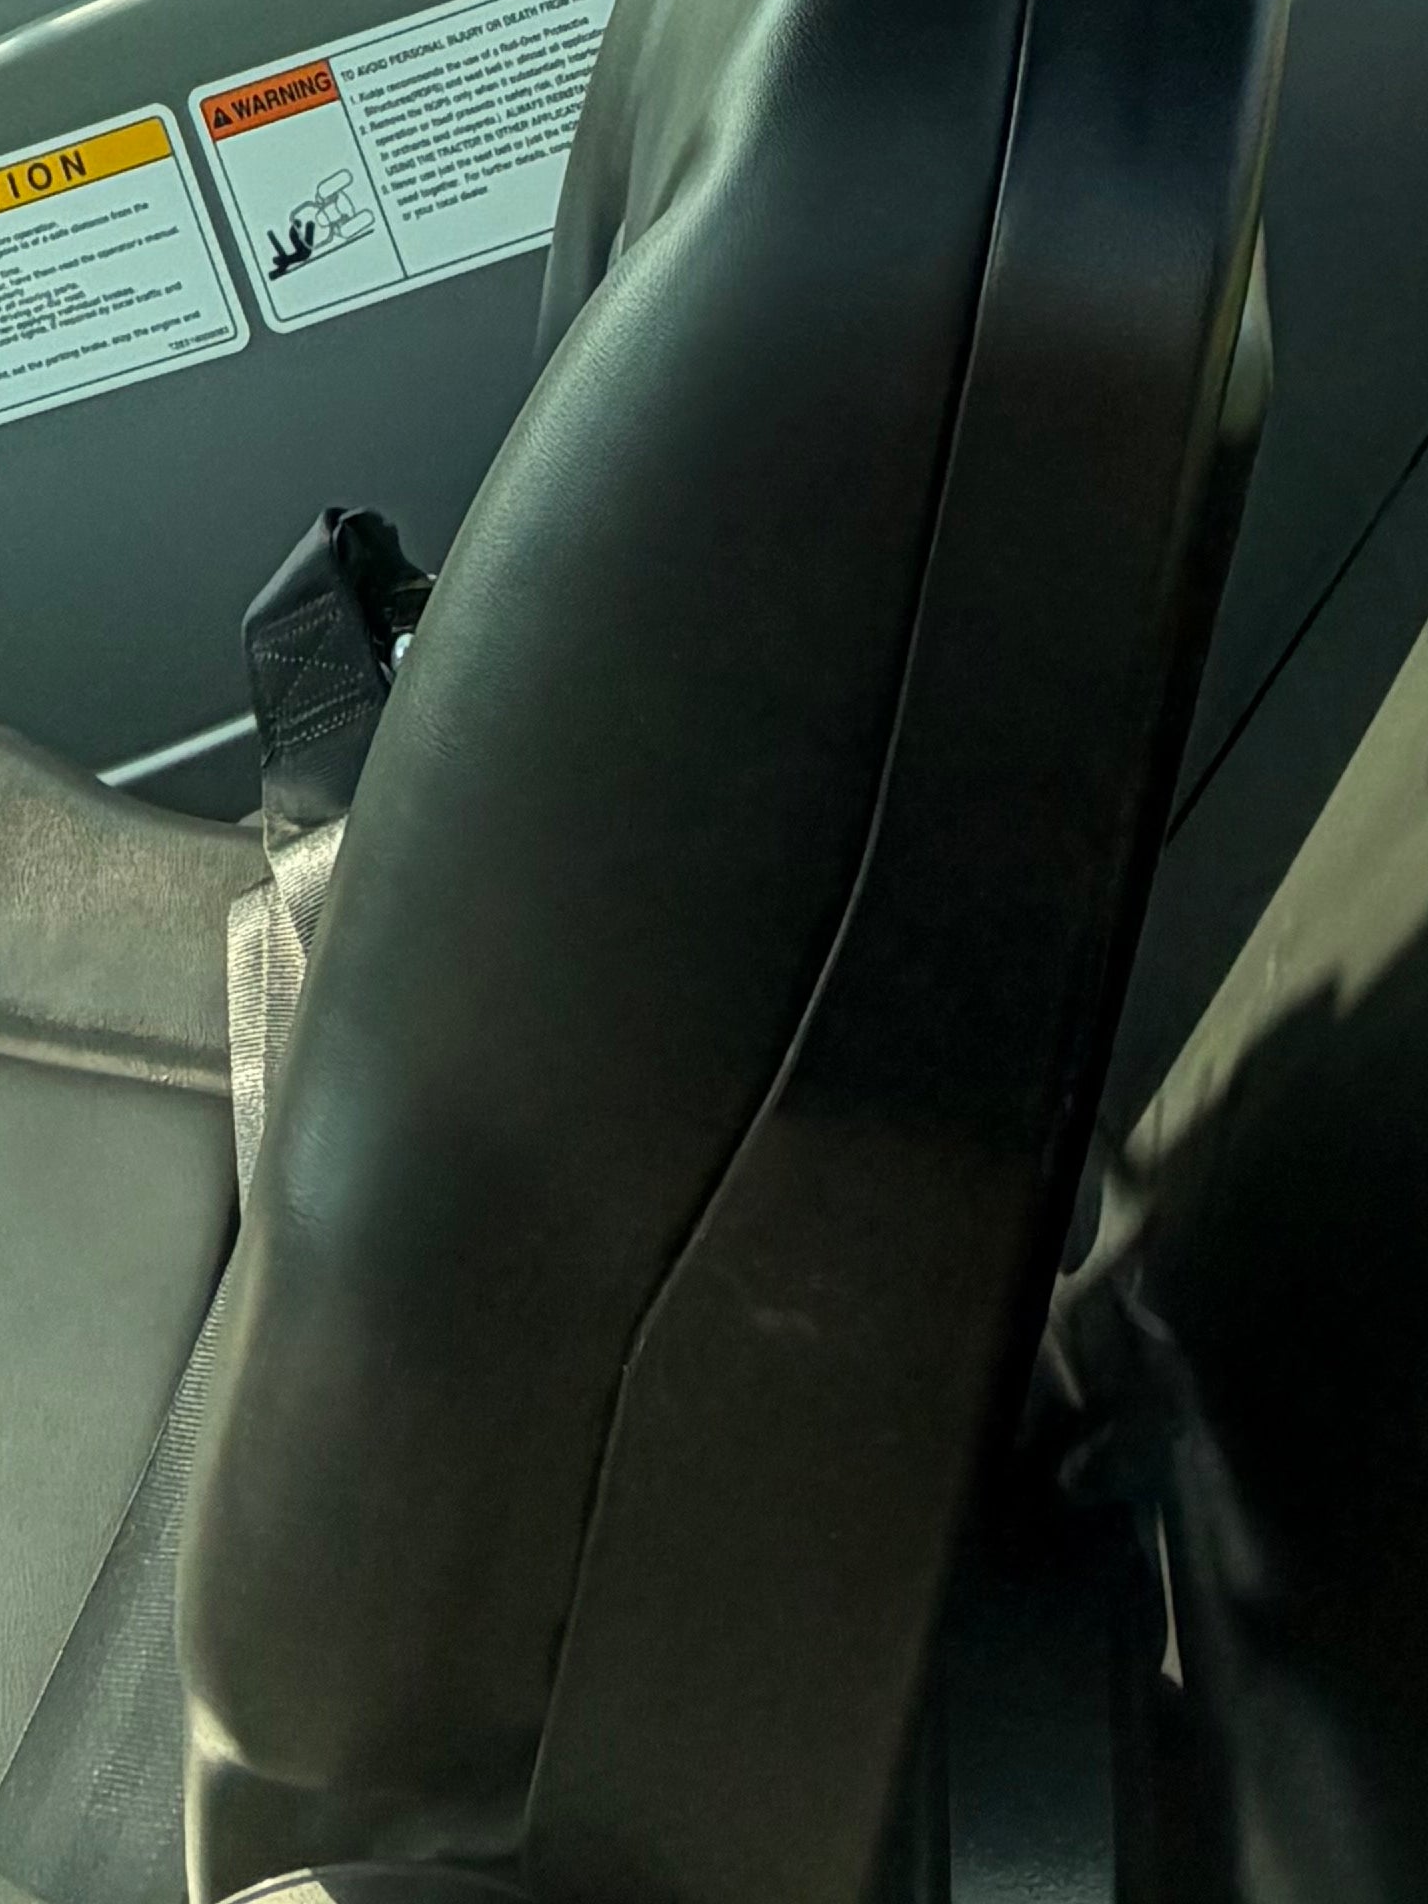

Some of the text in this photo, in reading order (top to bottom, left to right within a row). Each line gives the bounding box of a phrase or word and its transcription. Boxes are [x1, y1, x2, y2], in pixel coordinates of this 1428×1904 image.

[356, 57, 388, 77] AVOID
[388, 38, 445, 65] PERSONAL
[445, 24, 483, 46] INJURY
[502, 5, 538, 27] DEATH
[230, 70, 334, 122] WARNING
